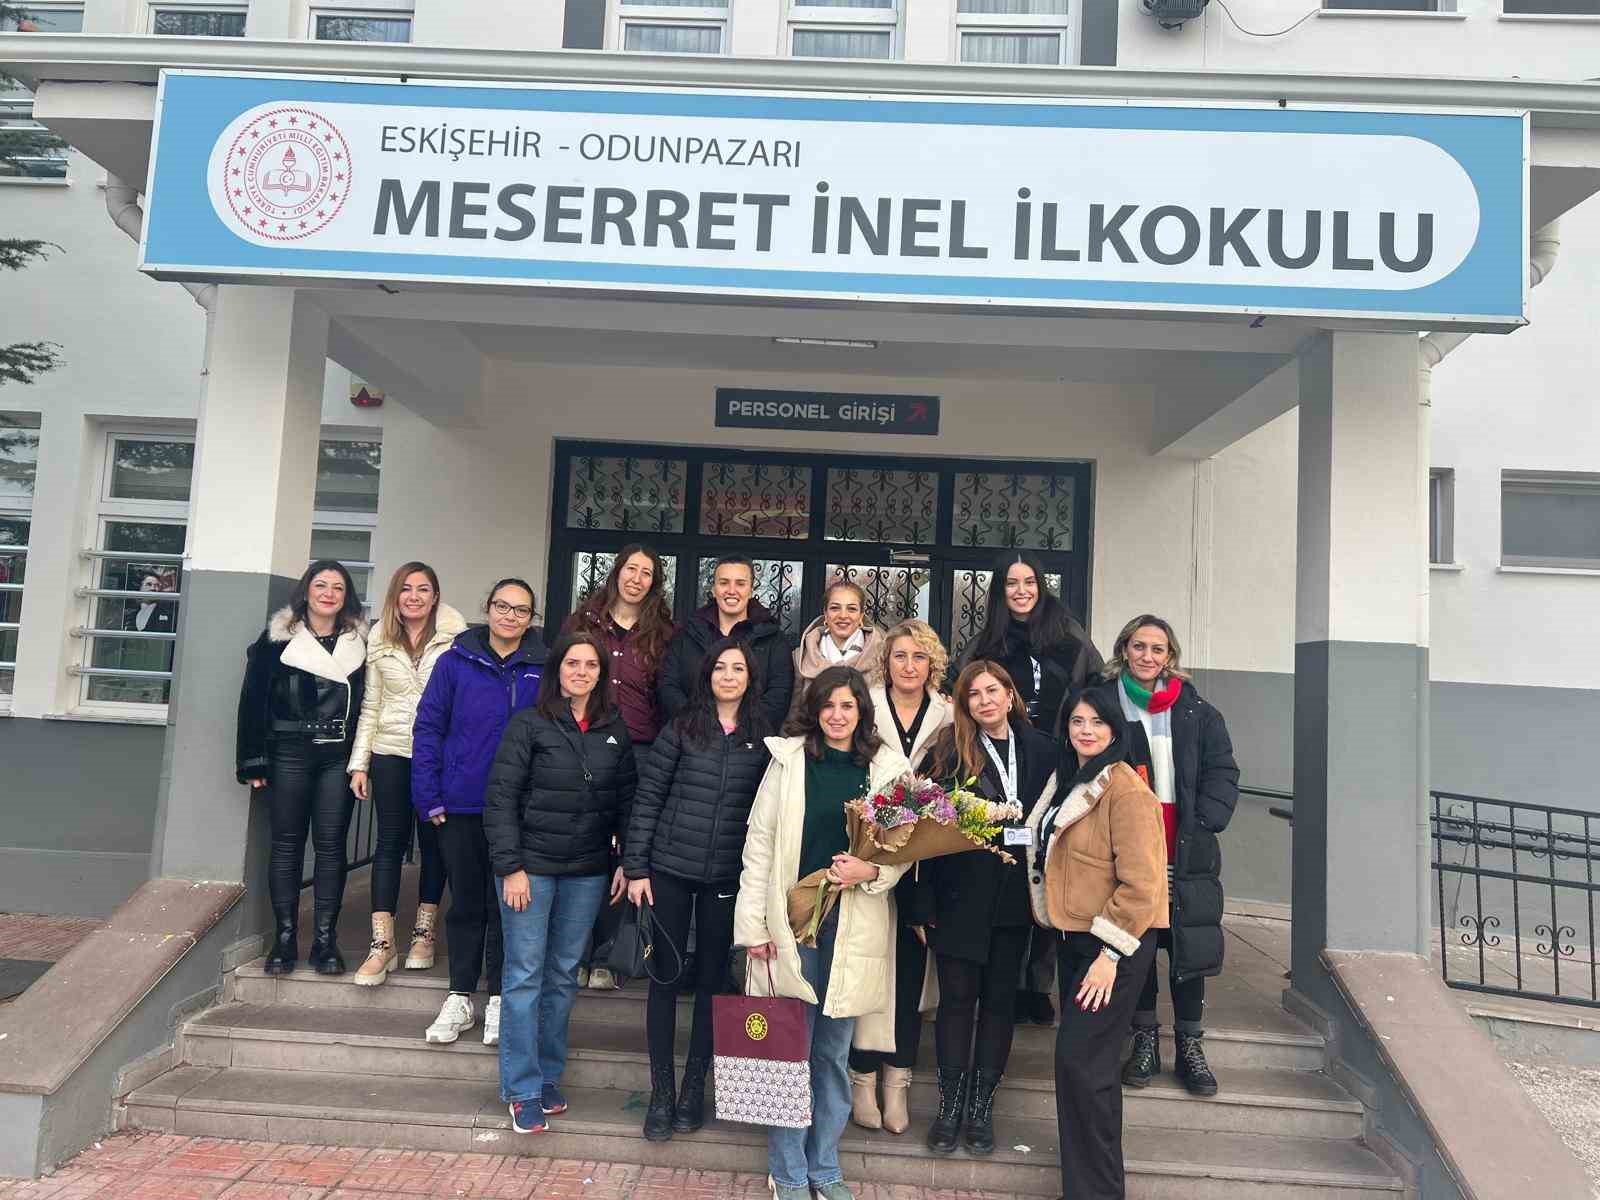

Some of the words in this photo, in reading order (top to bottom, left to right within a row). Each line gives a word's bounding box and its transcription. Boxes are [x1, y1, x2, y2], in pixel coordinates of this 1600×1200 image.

[380, 122, 541, 162] ESKİŞEHİR
[579, 133, 801, 168] ODUNPAZARI
[373, 178, 790, 252] MESERRET
[811, 181, 989, 260] İNEL
[1014, 187, 1434, 274] İLKOKULU
[728, 400, 830, 420] PERSONEL
[839, 401, 895, 425] GİRİŞİ
